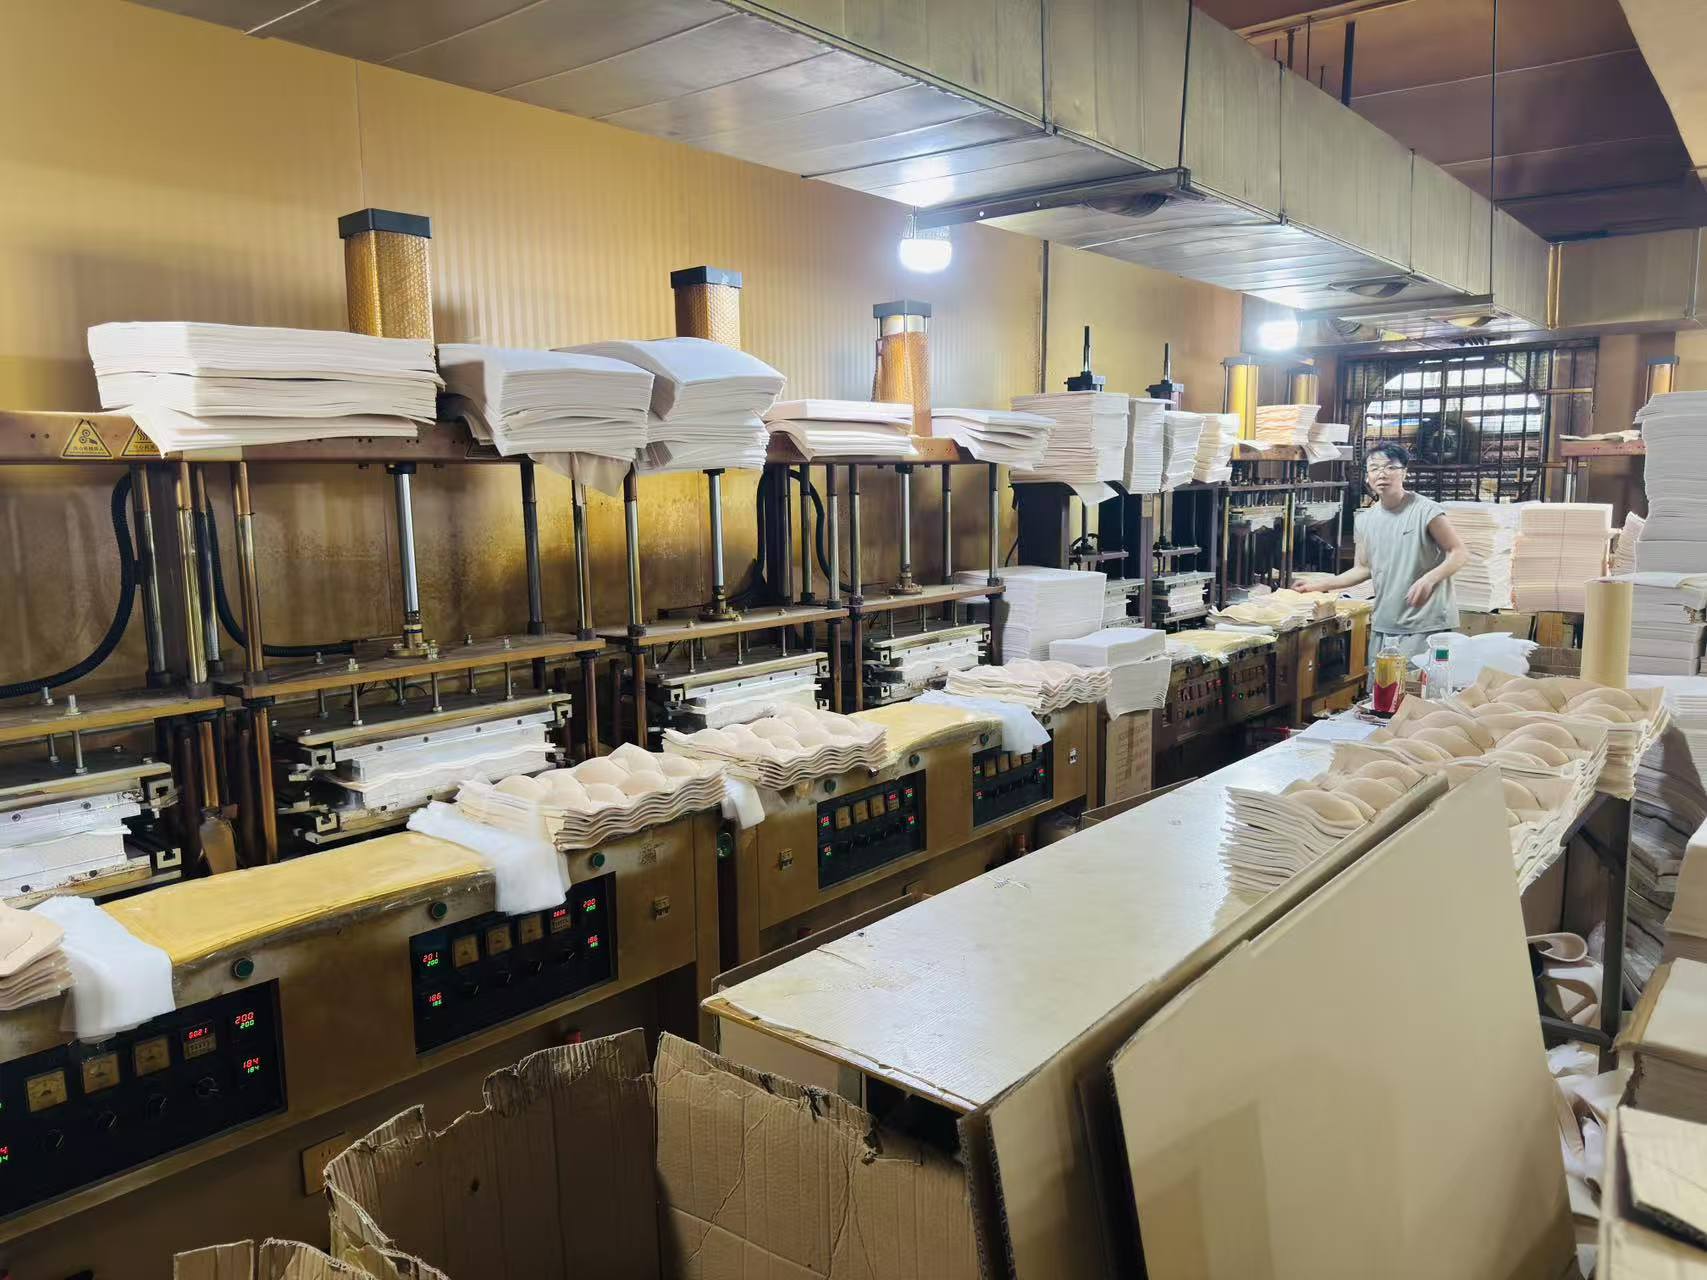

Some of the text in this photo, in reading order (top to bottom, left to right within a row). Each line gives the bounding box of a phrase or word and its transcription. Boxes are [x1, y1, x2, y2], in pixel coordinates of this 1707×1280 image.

[422, 951, 438, 963] 201
[235, 1011, 254, 1024] 200
[240, 1020, 254, 1029] 200
[243, 1057, 259, 1069] 184
[248, 1065, 260, 1074] 184
